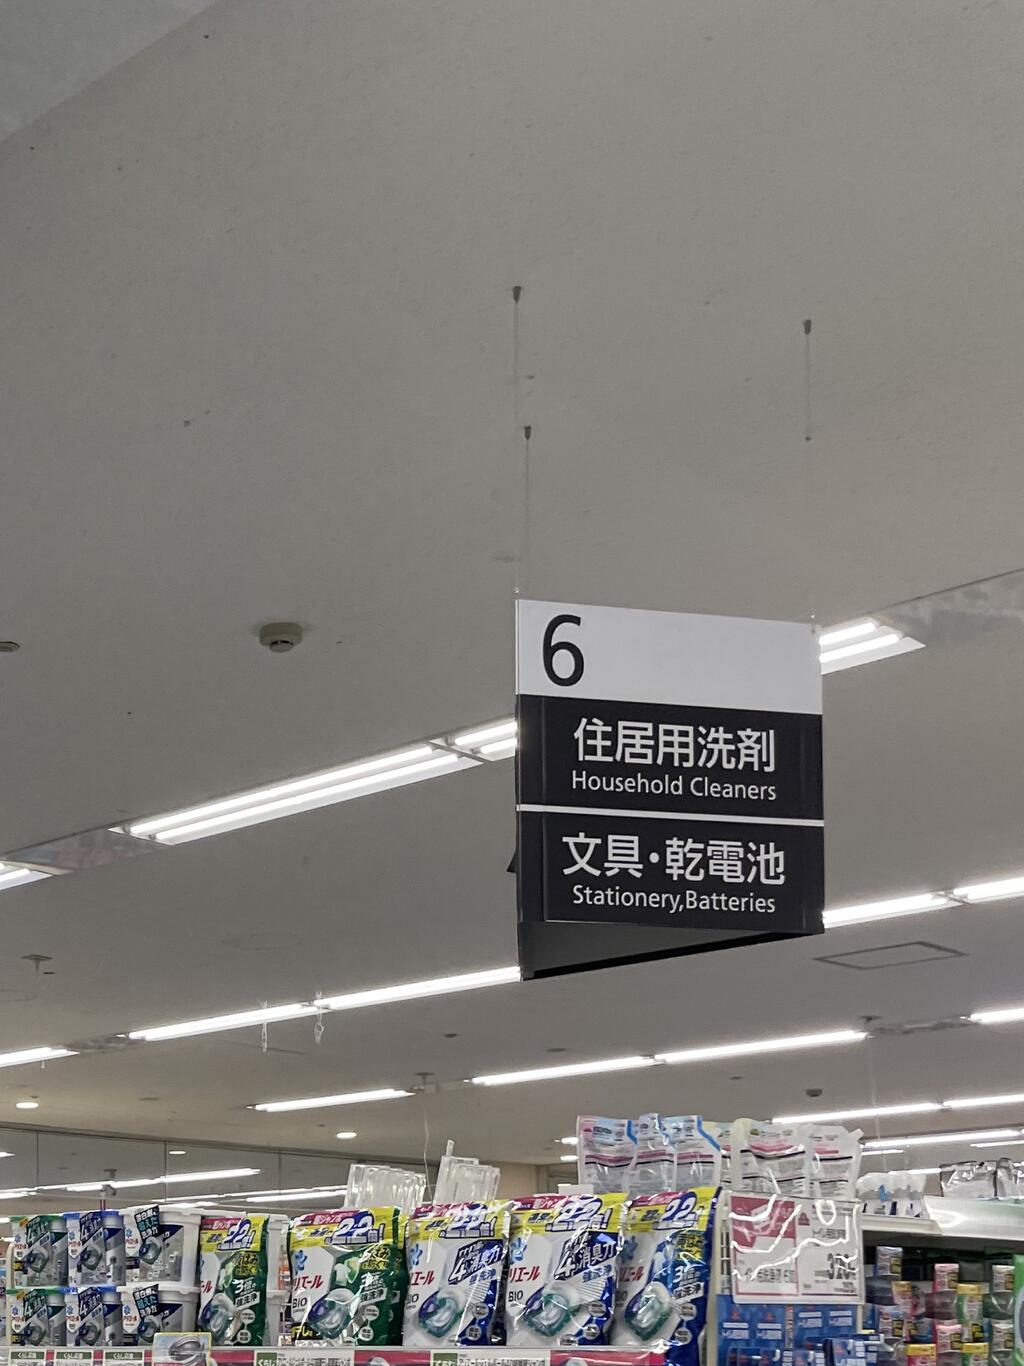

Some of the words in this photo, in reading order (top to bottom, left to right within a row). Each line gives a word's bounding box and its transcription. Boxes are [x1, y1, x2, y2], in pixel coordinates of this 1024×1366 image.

[542, 614, 584, 687] 6
[573, 718, 775, 772] 住居用洗剤
[572, 771, 682, 796] Household
[690, 777, 776, 801] Cleaners
[562, 833, 784, 885] 文具・乾電池
[573, 886, 775, 913] Stationery,Batteries
[508, 1290, 523, 1302] BIO
